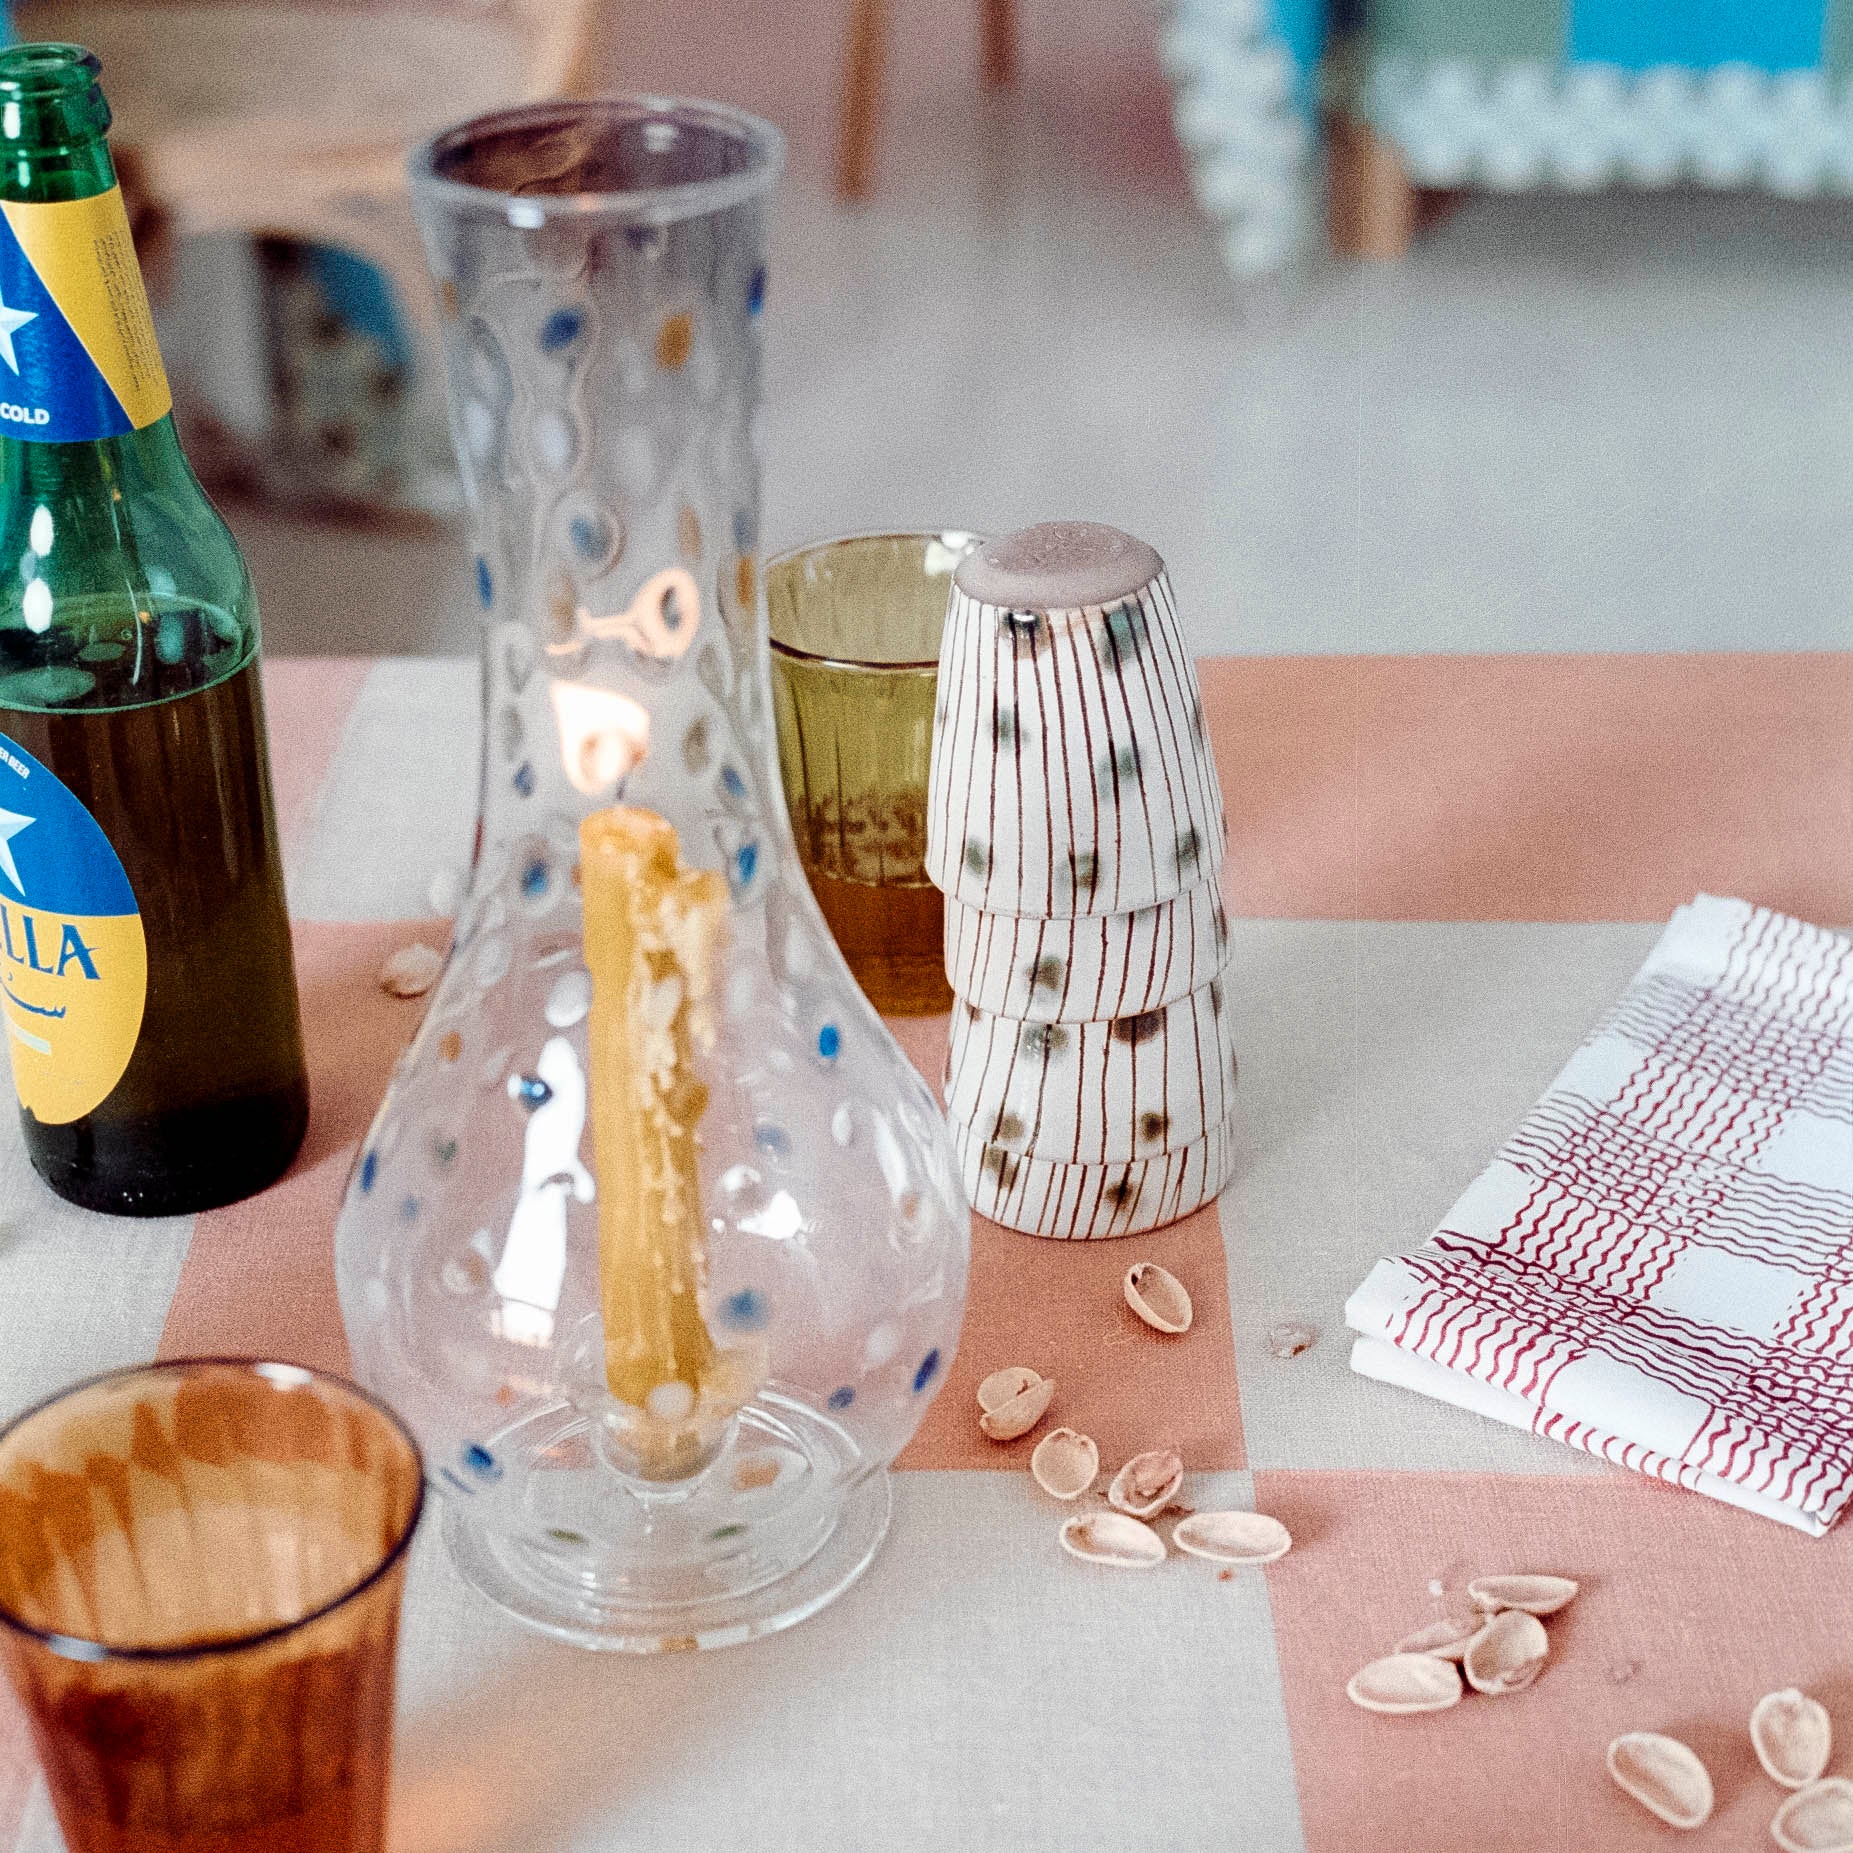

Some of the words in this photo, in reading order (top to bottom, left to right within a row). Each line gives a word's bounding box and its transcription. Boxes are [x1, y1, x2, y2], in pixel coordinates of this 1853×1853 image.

[0, 402, 50, 425] COLD
[7, 755, 31, 780] BEER
[0, 903, 102, 980] LLA
